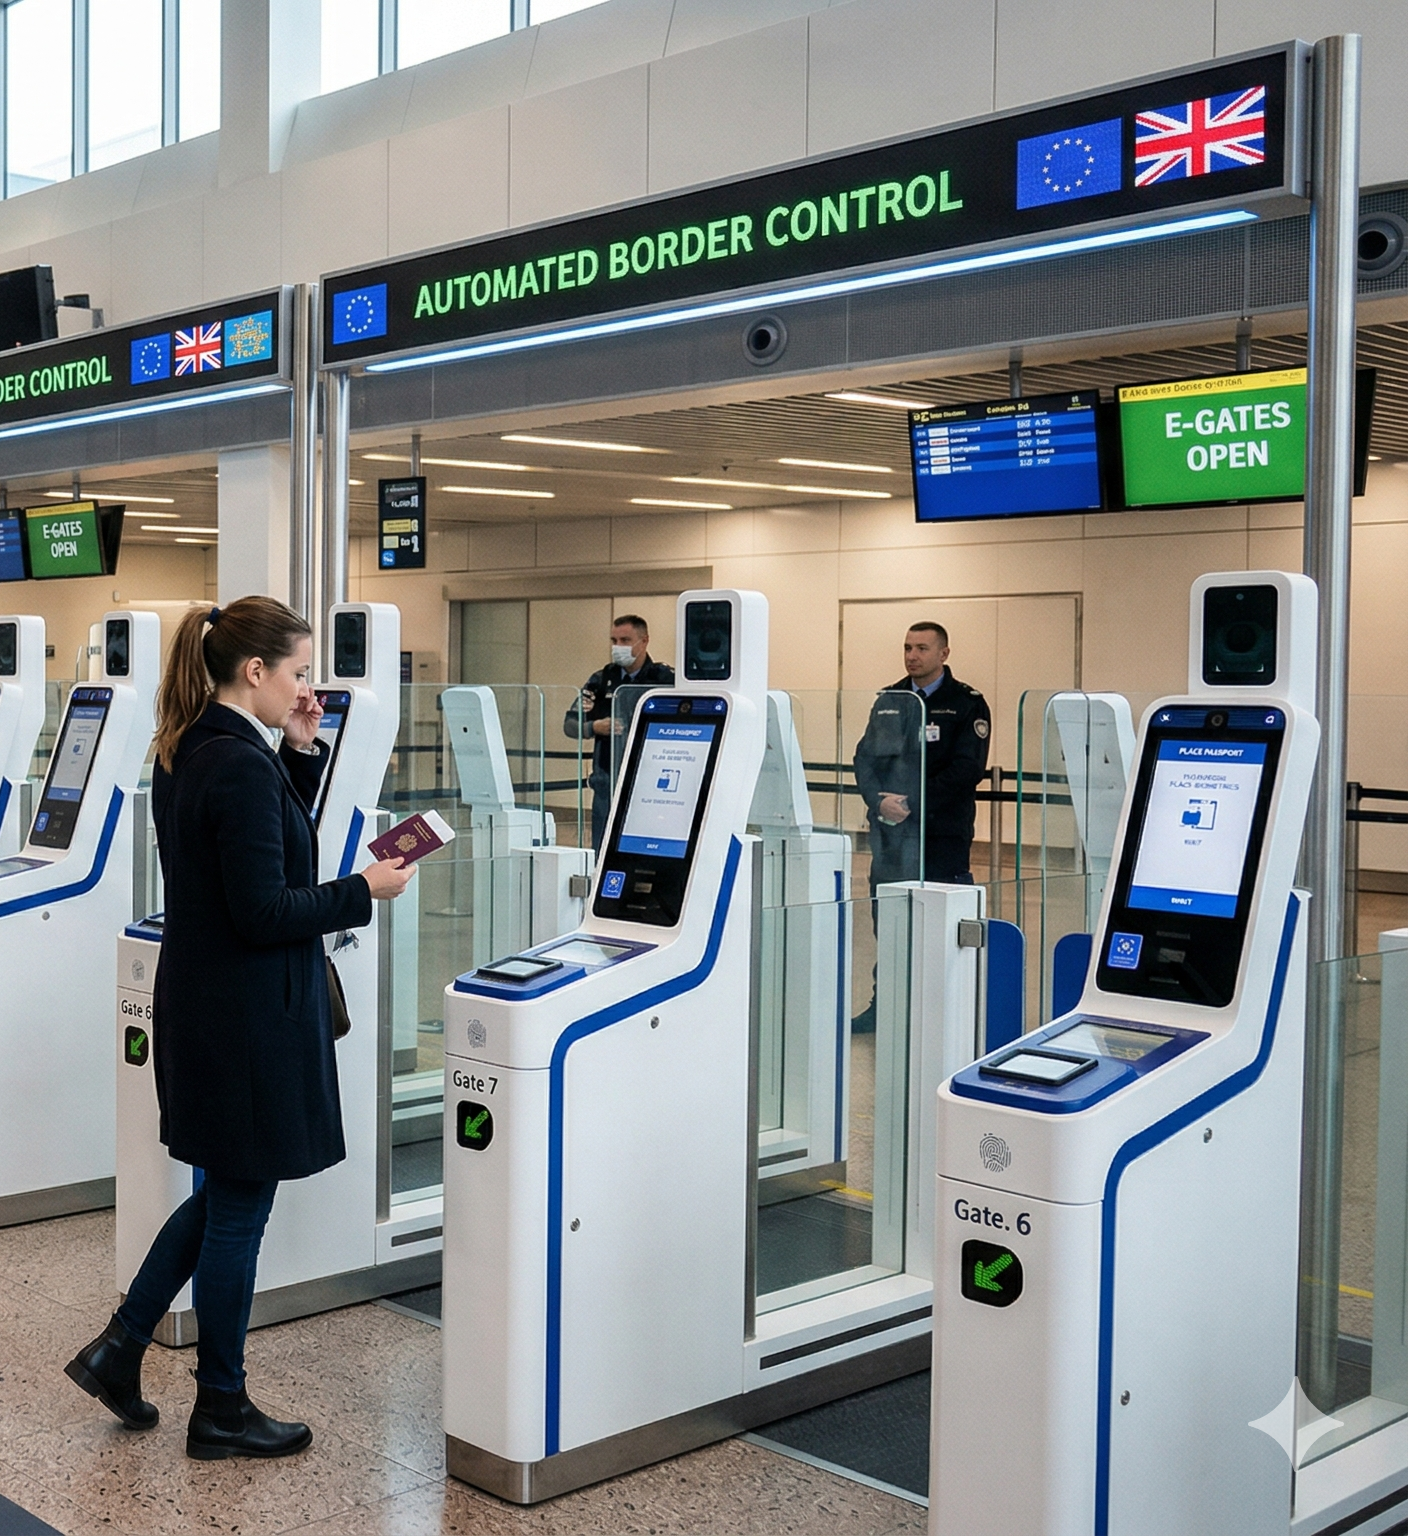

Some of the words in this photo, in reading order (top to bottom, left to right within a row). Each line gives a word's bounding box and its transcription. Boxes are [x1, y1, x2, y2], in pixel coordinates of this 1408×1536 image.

[414, 249, 600, 319] AUTOMATED
[609, 214, 754, 280] BORDER
[765, 170, 964, 247] CONTROL
[30, 355, 112, 397] CONTROL
[1165, 401, 1292, 439] E-GATES
[1186, 440, 1270, 472] OPEN
[42, 520, 83, 539] E-GATES
[51, 541, 78, 558] OPEN
[145, 1004, 152, 1020] 6
[452, 1069, 485, 1093] Gate
[488, 1076, 499, 1095] 7
[954, 1198, 1010, 1231] Gate.
[1016, 1212, 1032, 1236] 6
